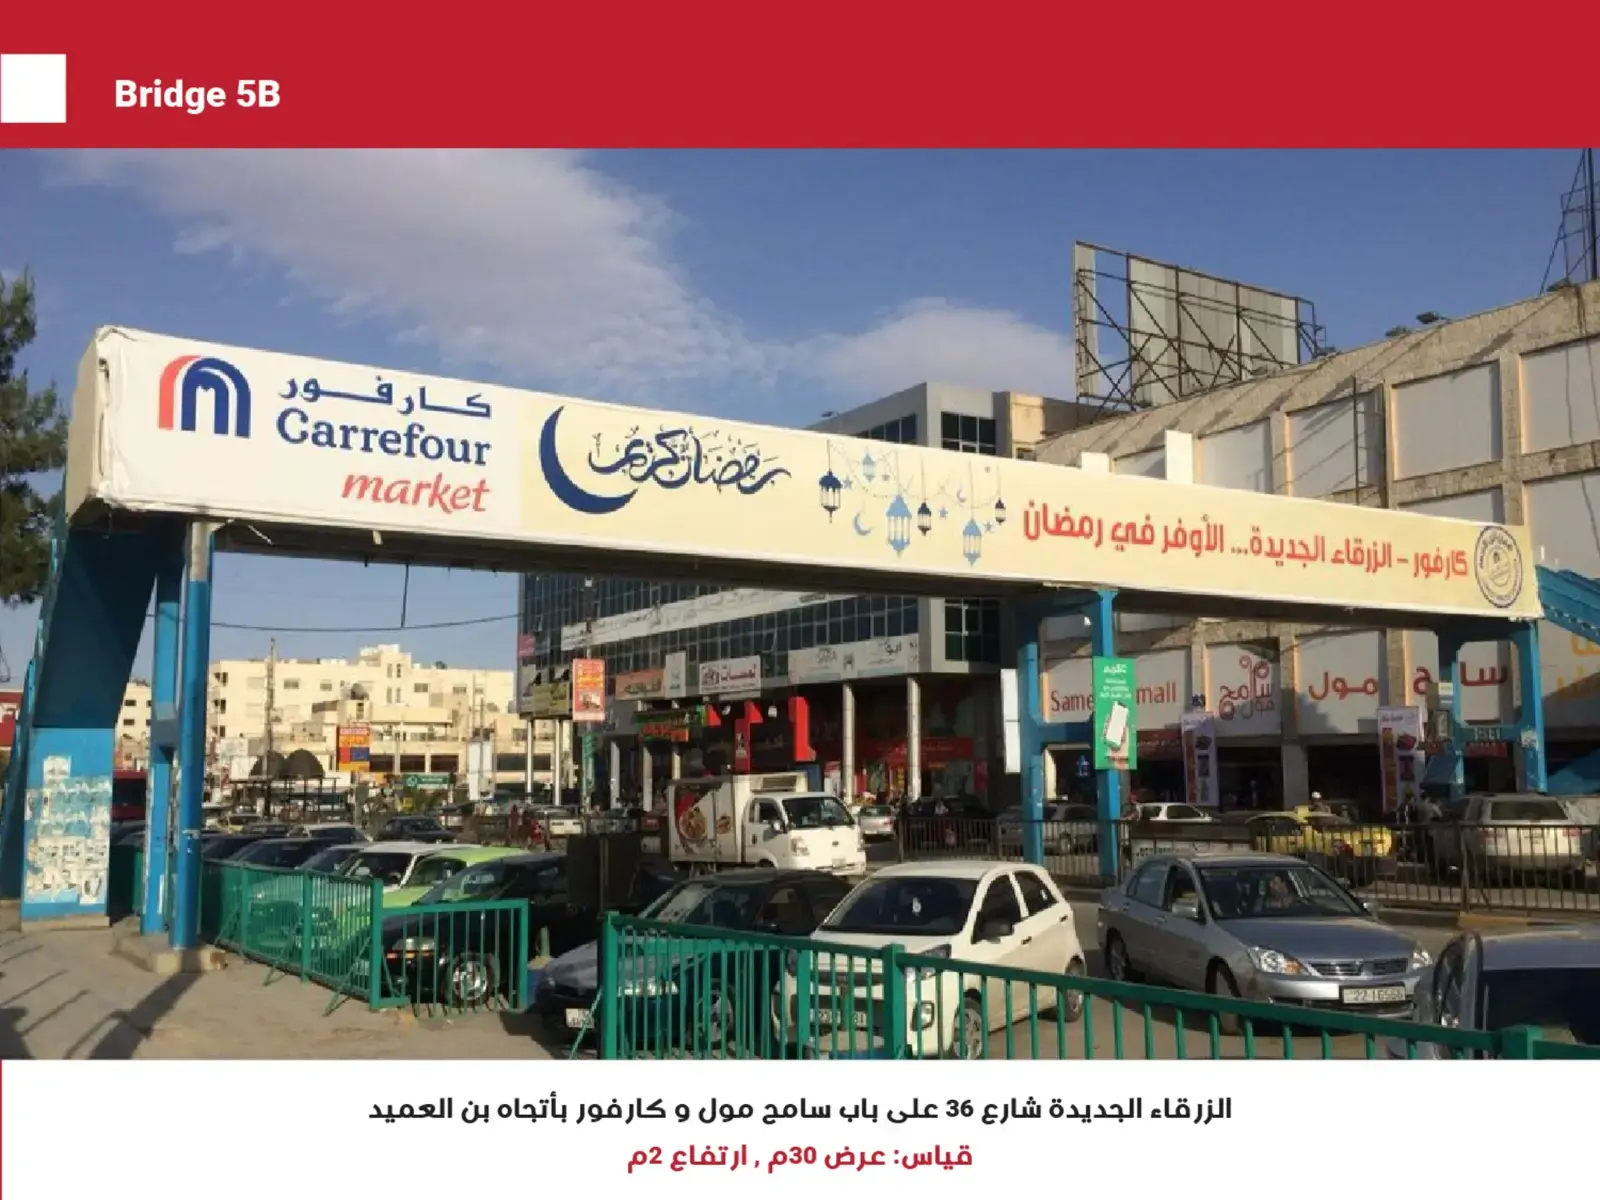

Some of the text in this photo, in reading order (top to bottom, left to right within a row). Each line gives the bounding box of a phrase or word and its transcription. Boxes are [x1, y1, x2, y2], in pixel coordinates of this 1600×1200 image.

[279, 375, 492, 418] كارفور
[276, 406, 492, 466] Carrefour
[588, 425, 792, 495] رمضان كريم
[341, 471, 491, 514] market
[1023, 499, 1104, 549] رمضان
[1110, 513, 1156, 553] في
[1160, 513, 1225, 558] الأوفر
[1330, 537, 1392, 574] الزرقاء
[1412, 547, 1469, 580] كارفور
[1051, 690, 1094, 712] Same
[1136, 681, 1177, 705] mall
[1308, 671, 1378, 700] مول
